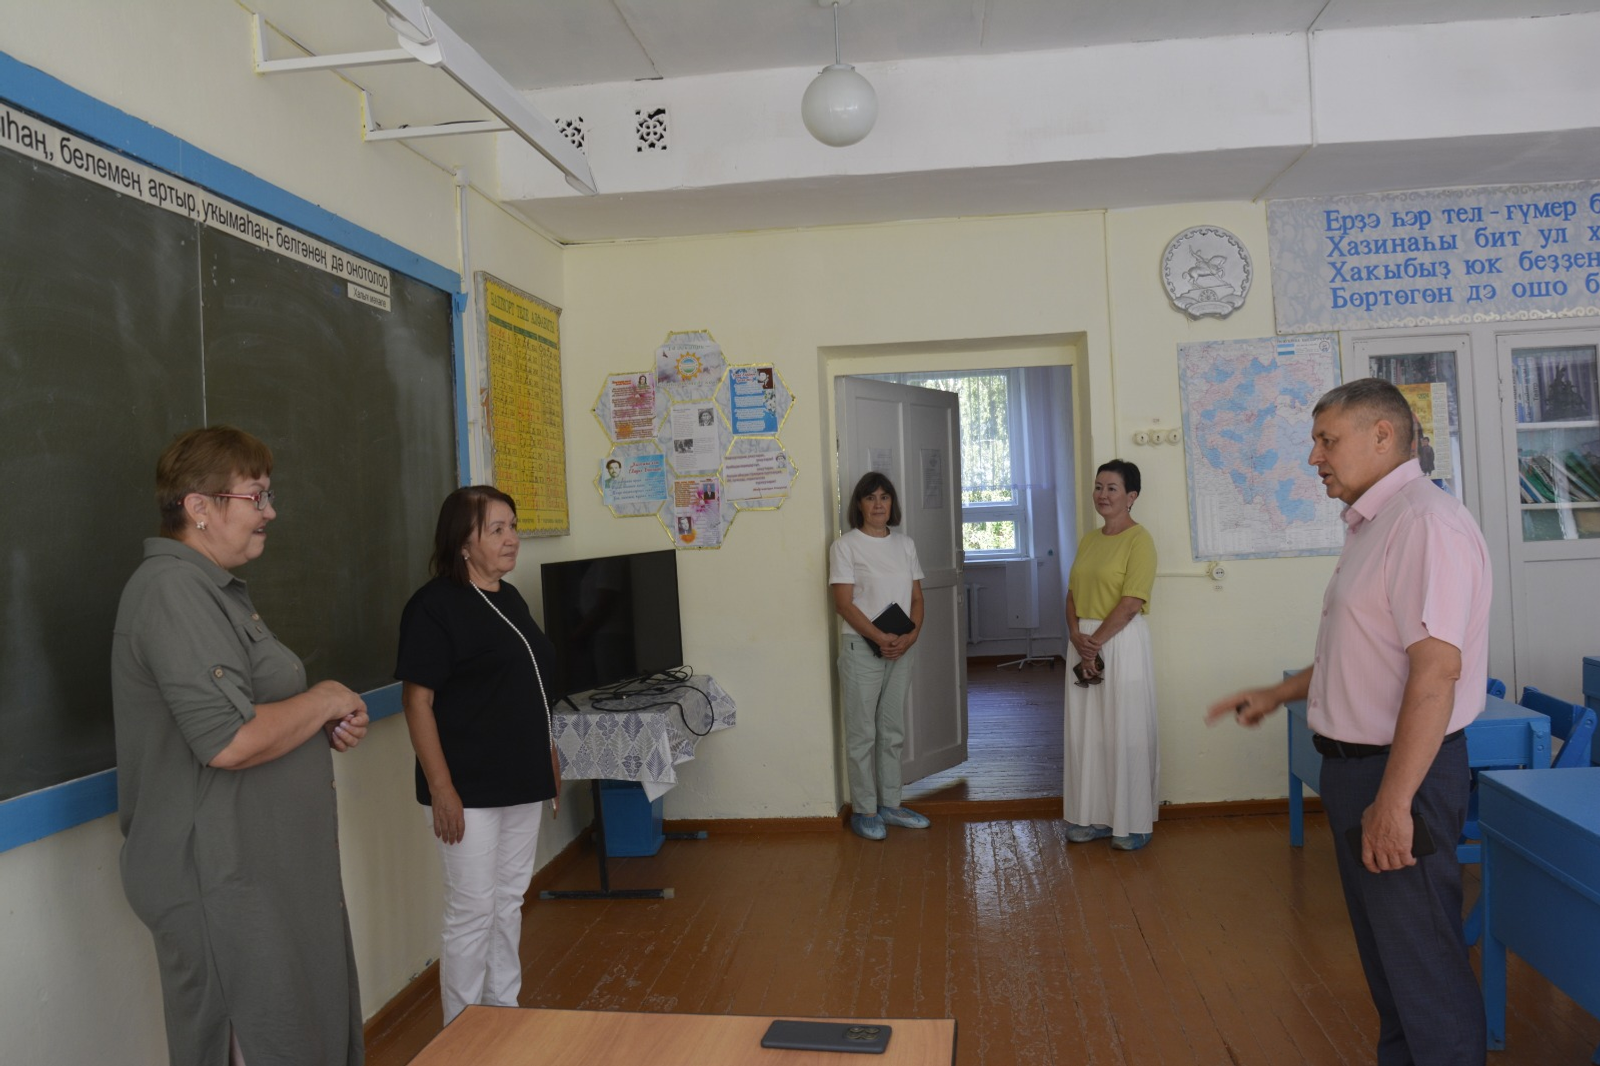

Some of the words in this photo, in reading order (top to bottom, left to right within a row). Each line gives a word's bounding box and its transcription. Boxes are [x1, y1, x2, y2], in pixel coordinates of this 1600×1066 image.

[60, 136, 142, 197] белемең
[148, 178, 200, 218] артыр,
[276, 227, 328, 269] белгәнең
[331, 254, 344, 273] дә
[346, 260, 389, 293] онотолор
[1323, 209, 1381, 235] Ерҙә
[1391, 209, 1432, 230] һәр
[1325, 233, 1459, 258] Хазинаһы
[1473, 226, 1522, 249] бит
[1538, 225, 1569, 249] ул
[1330, 286, 1454, 311] Бөртөгөн
[1466, 283, 1497, 304] дә
[1511, 279, 1569, 298] ошо
